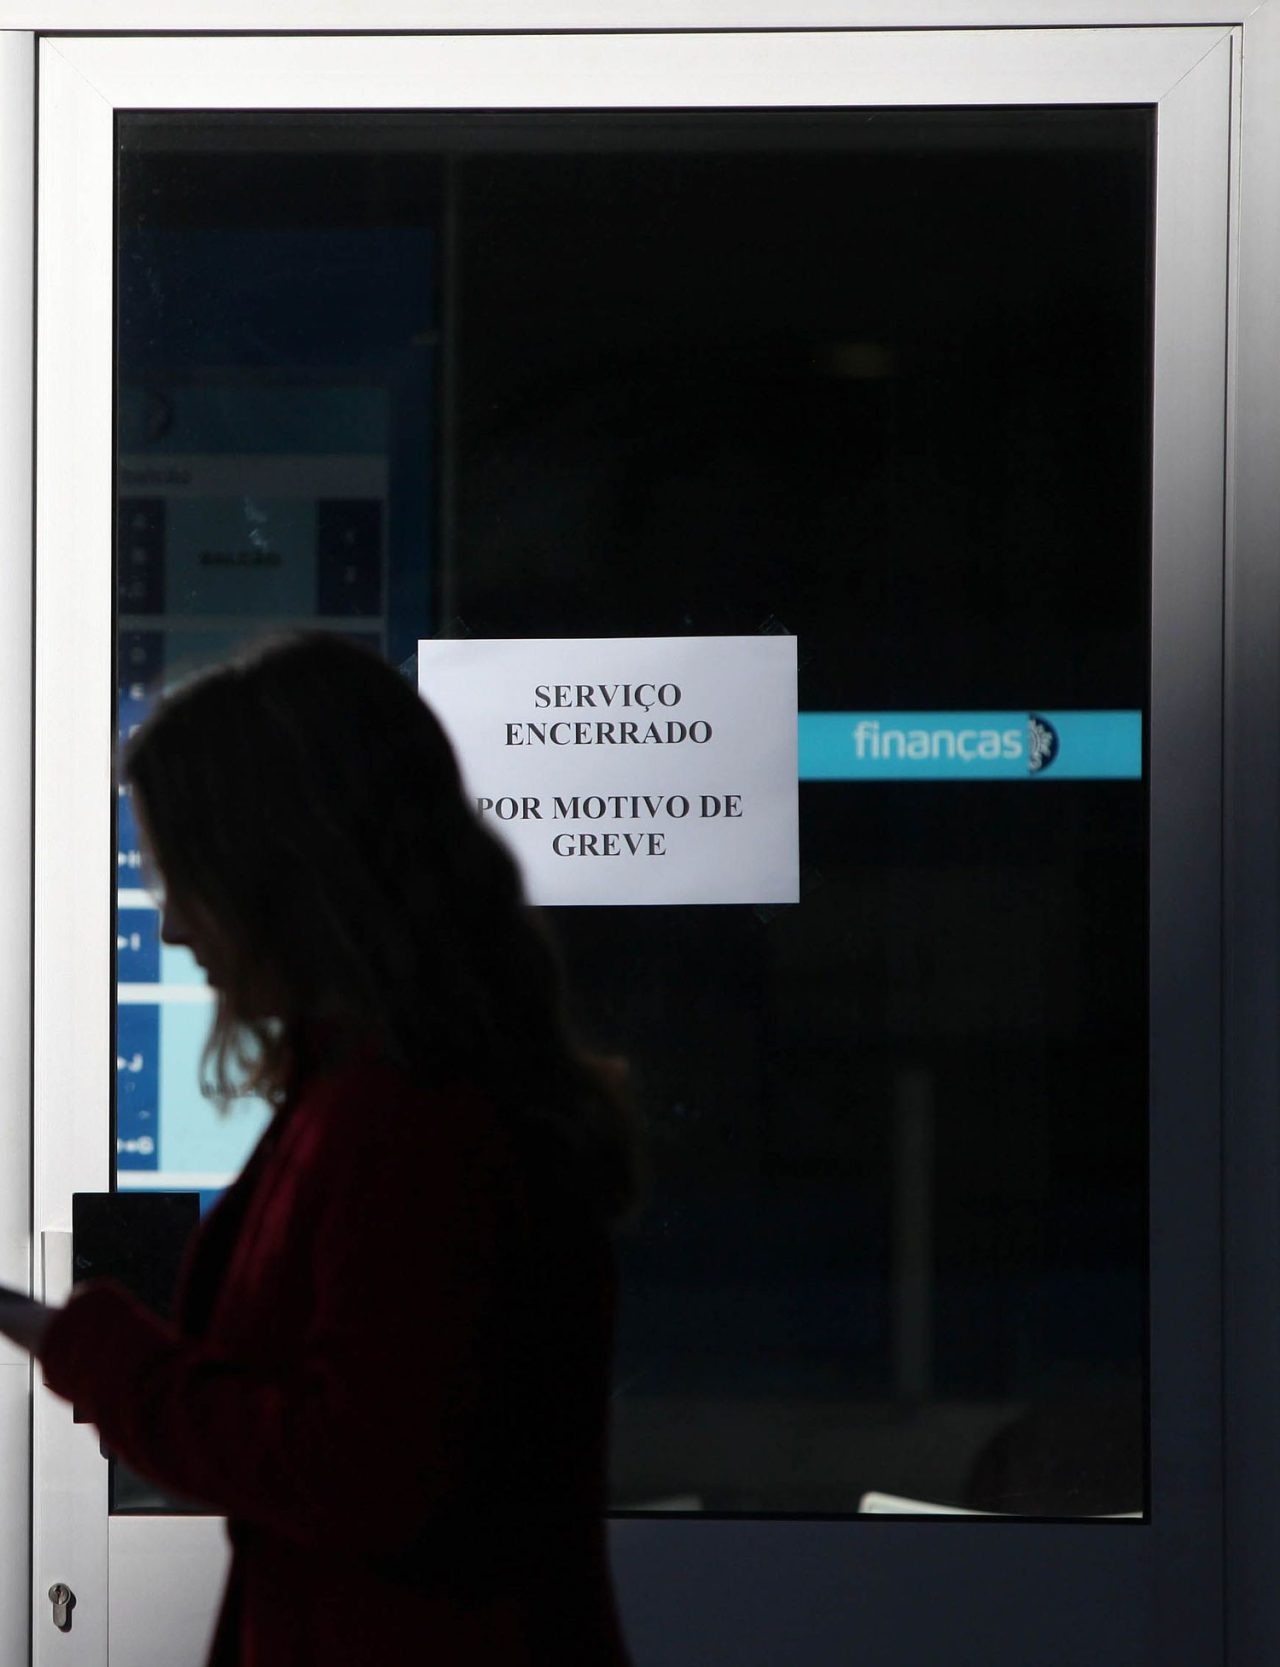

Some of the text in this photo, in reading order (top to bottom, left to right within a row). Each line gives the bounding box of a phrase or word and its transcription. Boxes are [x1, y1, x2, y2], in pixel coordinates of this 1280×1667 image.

[534, 683, 682, 713] SERVIÇO
[504, 720, 713, 746] ENCERRADO
[853, 720, 1024, 762] finanças
[477, 794, 743, 821] POR MOTIVO DE
[551, 832, 667, 857] GREVE
